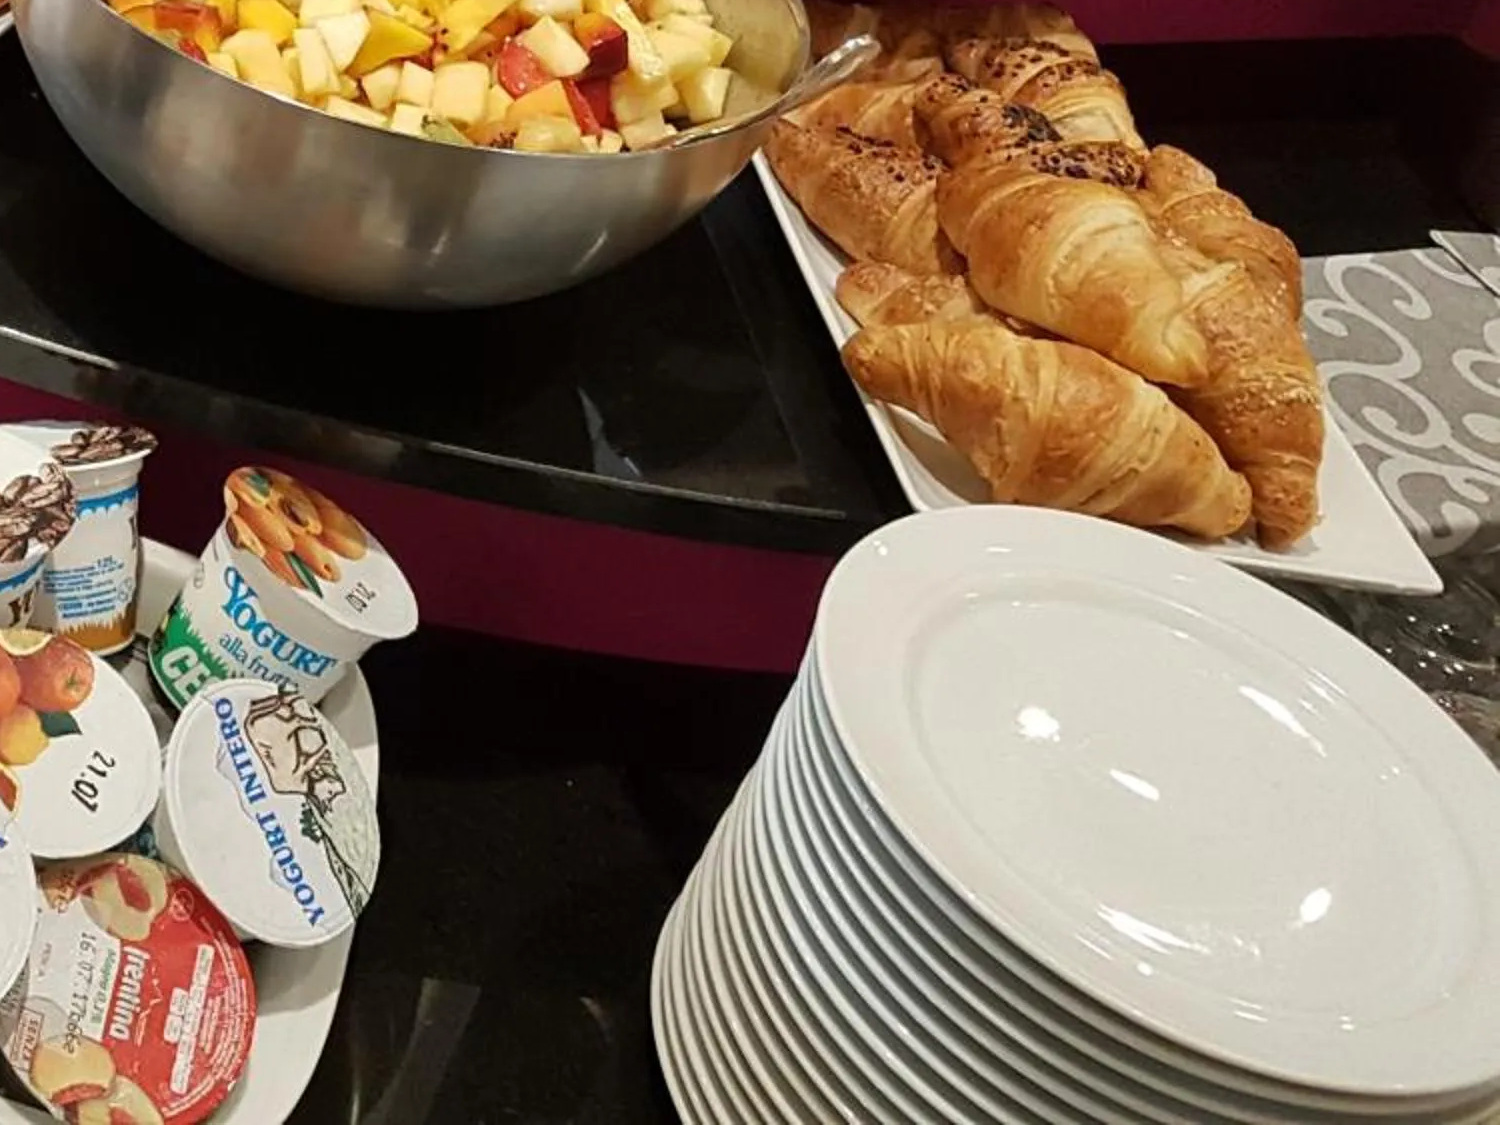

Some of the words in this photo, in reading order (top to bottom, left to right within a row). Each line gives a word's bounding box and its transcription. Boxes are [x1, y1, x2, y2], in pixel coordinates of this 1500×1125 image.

[218, 631, 249, 666] alla
[220, 566, 338, 678] YOGURT
[213, 696, 269, 805] INTERO
[255, 810, 326, 928] YOGURT
